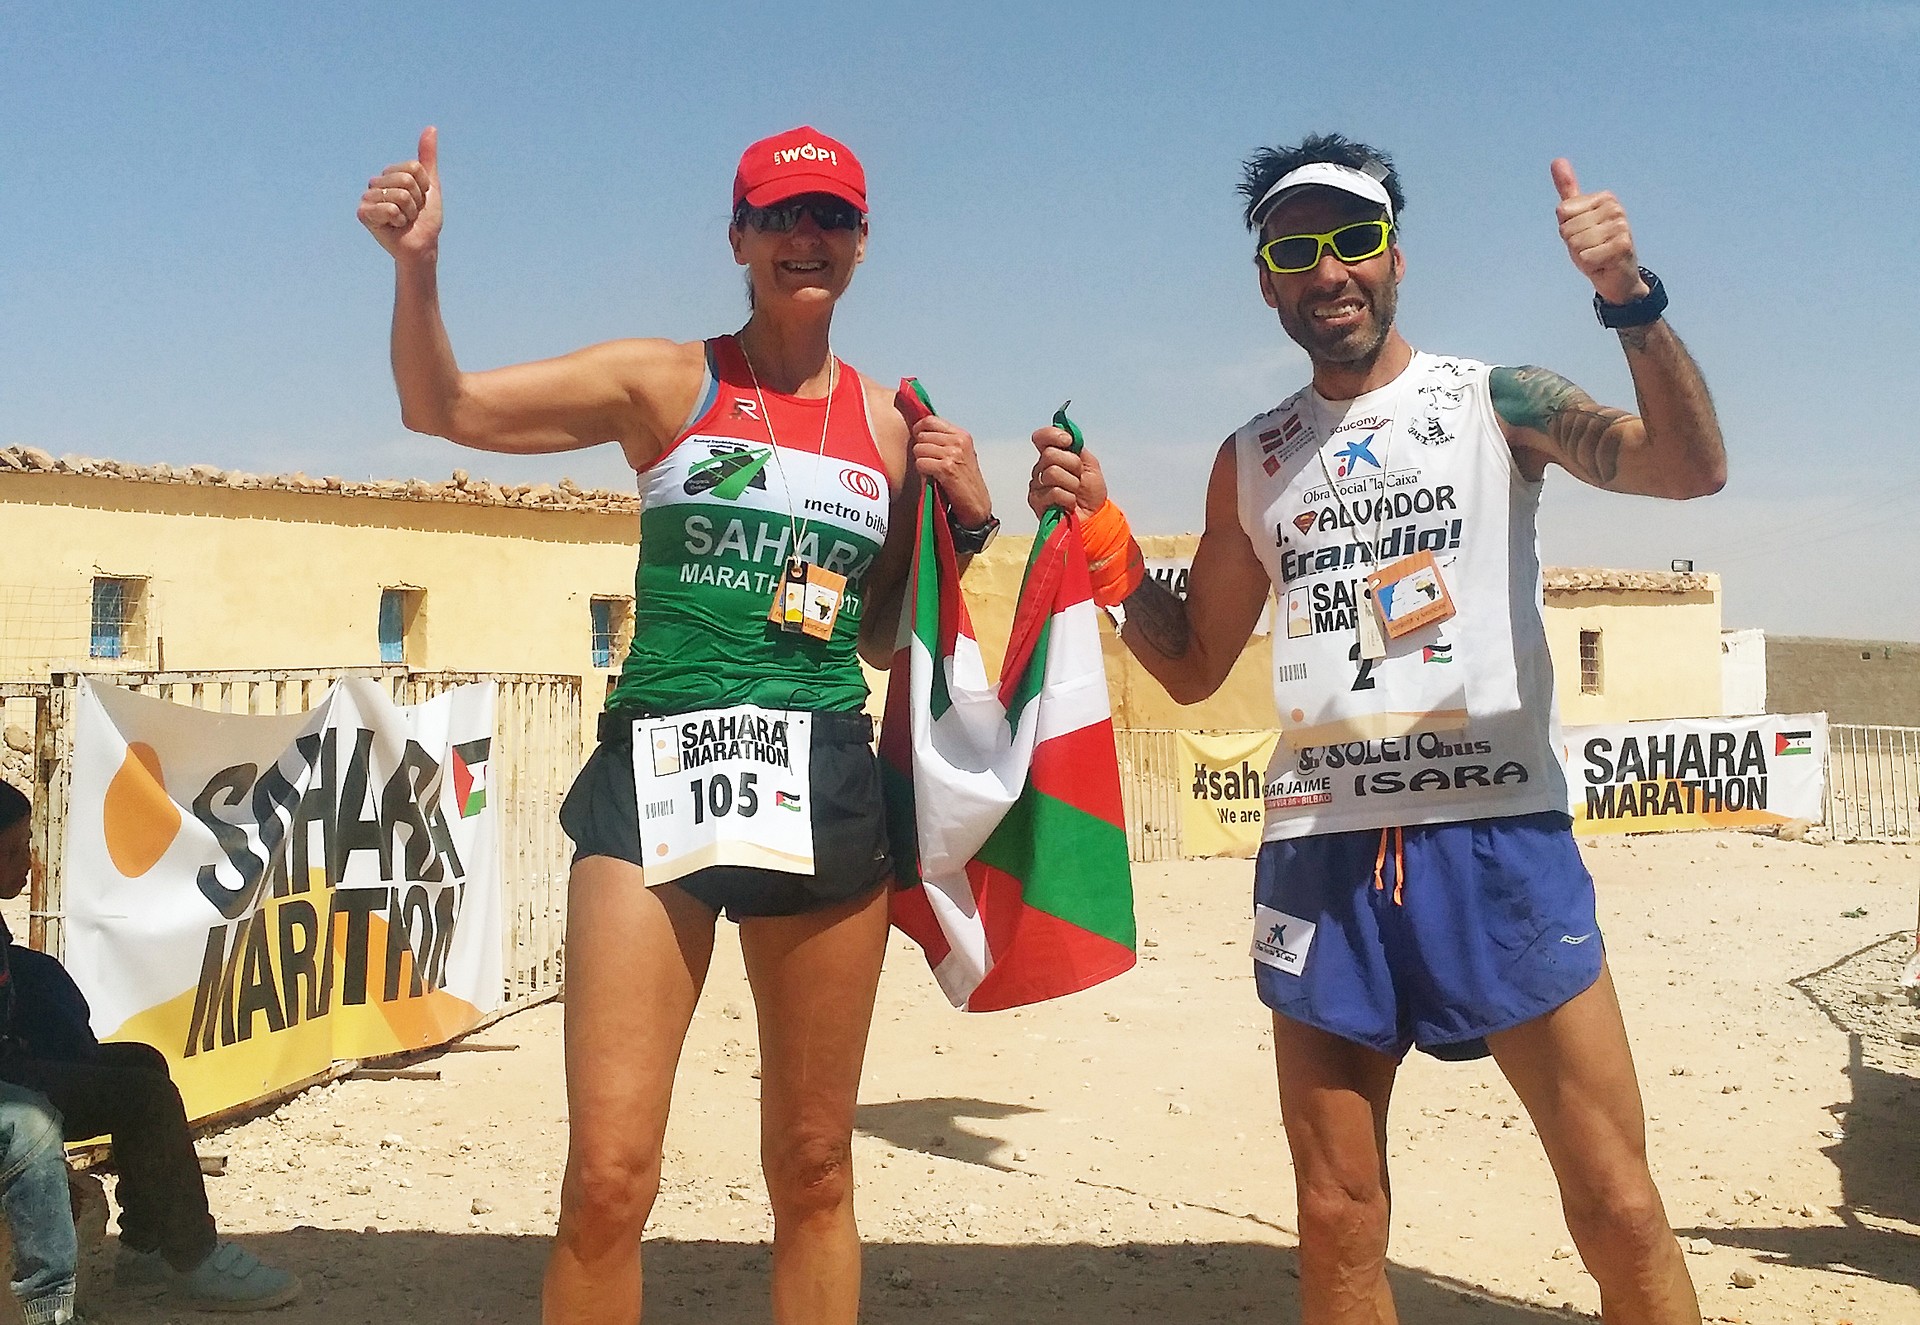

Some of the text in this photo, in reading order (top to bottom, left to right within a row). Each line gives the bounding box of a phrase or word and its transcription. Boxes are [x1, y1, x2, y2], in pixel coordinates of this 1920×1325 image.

[780, 143, 838, 166] WOP!
[1329, 415, 1378, 435] saucony
[1303, 490, 1330, 504] Obra
[1336, 480, 1367, 496] ocial
[1386, 470, 1422, 488] Caixa"
[804, 498, 860, 522] metro
[1275, 522, 1289, 547] J.
[684, 514, 875, 590] SAHARA
[680, 563, 778, 594] MARATH
[681, 714, 790, 750] SAHARA
[682, 740, 790, 770] MARATHON
[1584, 730, 1768, 784] SAHARA
[1192, 761, 1263, 800] #sah
[1286, 776, 1331, 795] JAIME
[1354, 761, 1529, 796] ISARA
[690, 771, 758, 825] 105
[1585, 776, 1768, 820] MARATHON
[192, 727, 465, 920] SAHARA
[1217, 808, 1261, 824] We are
